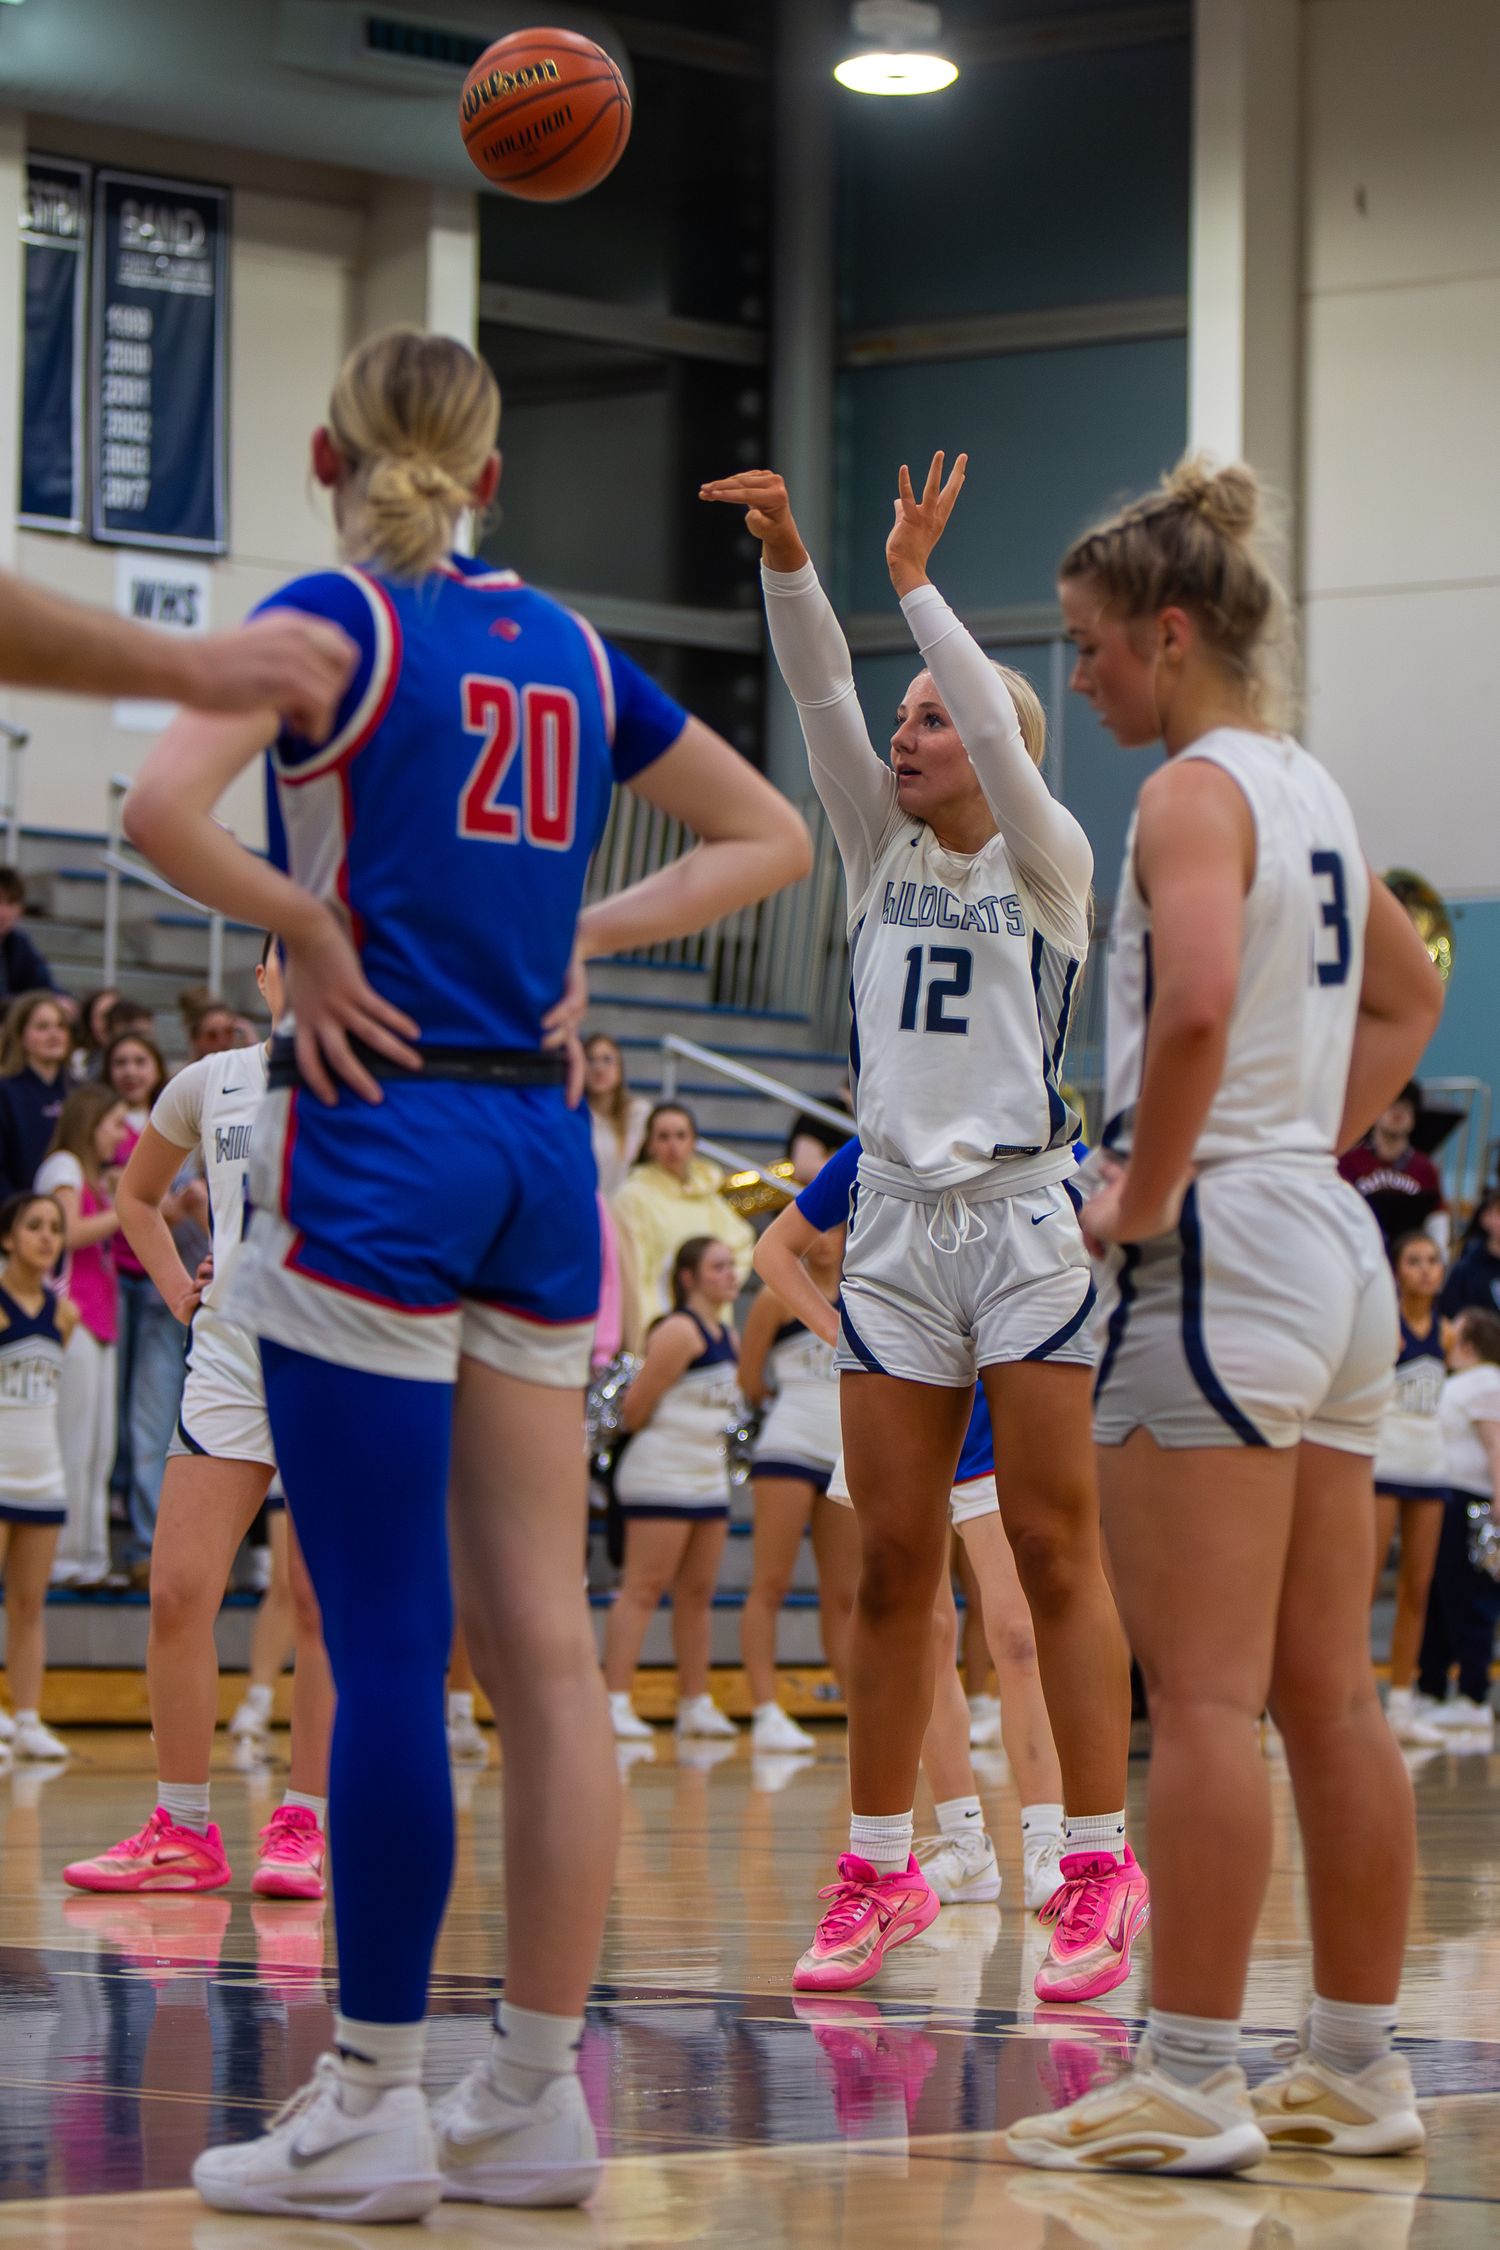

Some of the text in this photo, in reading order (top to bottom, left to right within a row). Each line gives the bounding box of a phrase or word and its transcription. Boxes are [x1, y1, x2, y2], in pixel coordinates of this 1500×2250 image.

[131, 577, 200, 626] WHS
[457, 672, 579, 852] 20
[882, 880, 1026, 937] WILDCATS
[1310, 850, 1352, 986] 3
[898, 944, 975, 1037] 12
